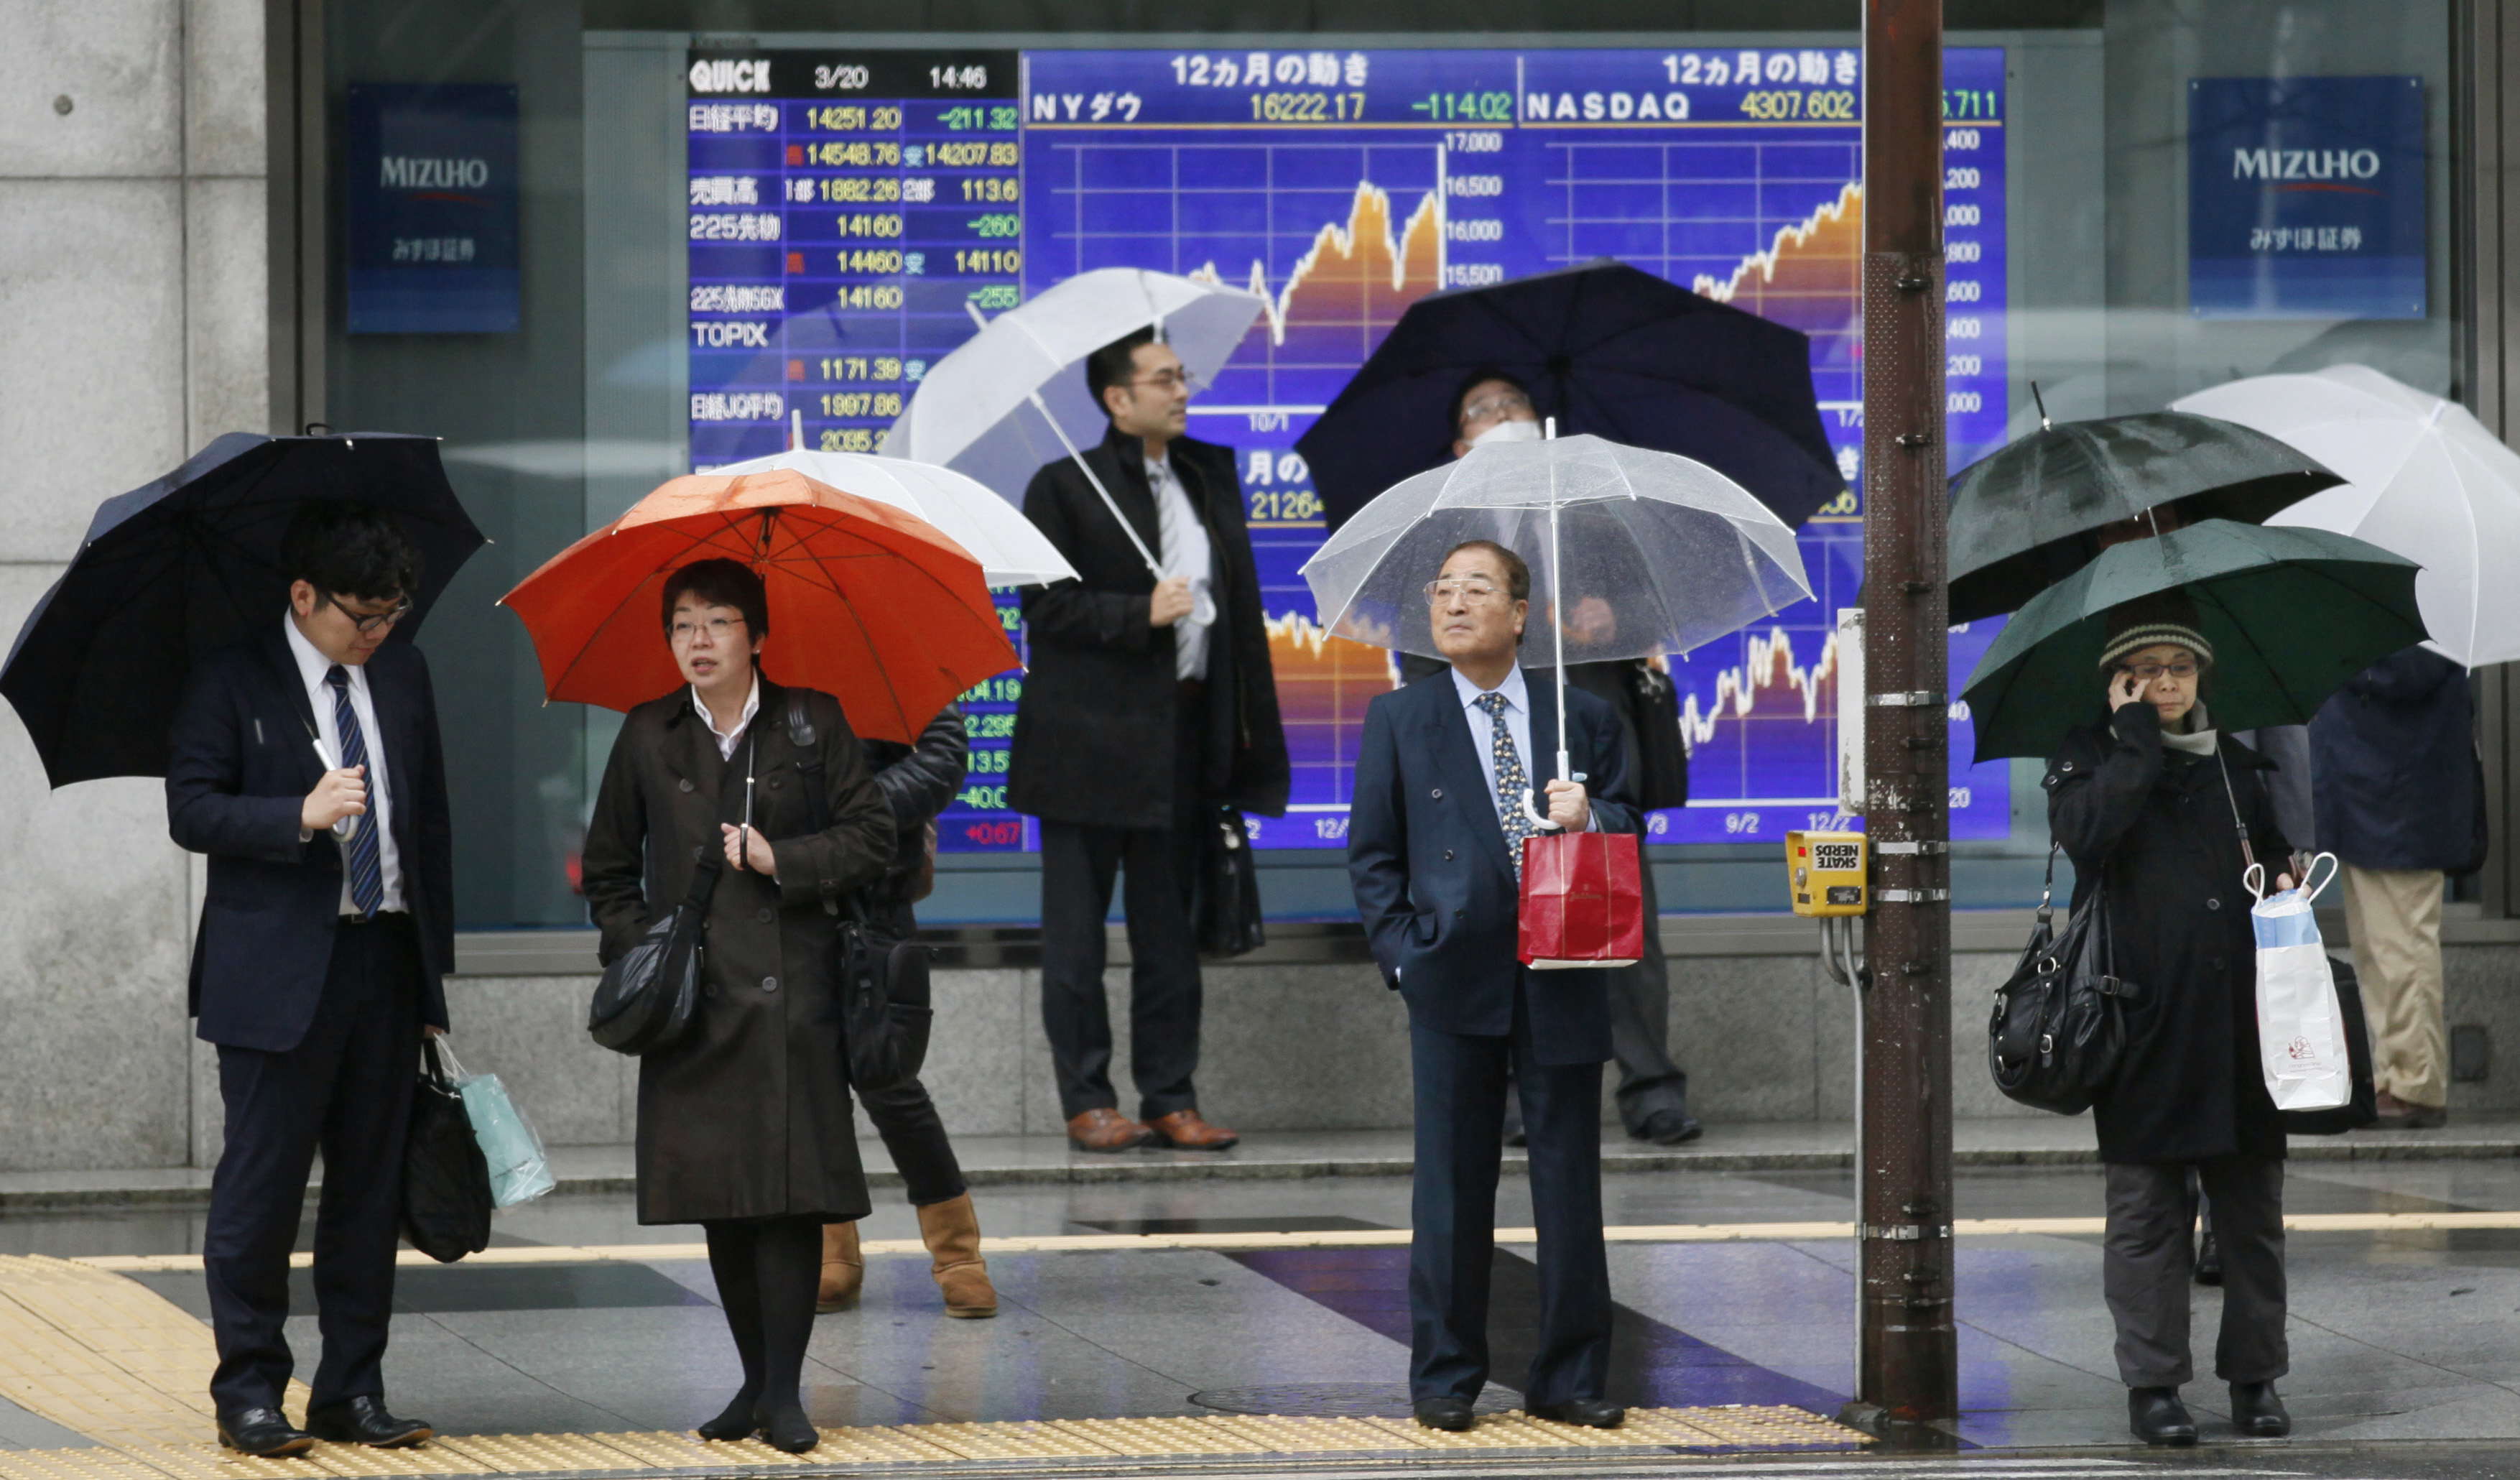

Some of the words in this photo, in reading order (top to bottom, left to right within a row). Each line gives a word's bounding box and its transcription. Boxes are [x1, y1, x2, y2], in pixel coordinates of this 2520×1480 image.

[689, 60, 771, 92] QUICK
[815, 65, 869, 89] 3/20
[930, 65, 988, 89] 14:46
[690, 103, 778, 132] 日経平均
[807, 106, 902, 130] 14251.20
[937, 106, 1019, 130] -211.32
[1250, 93, 1365, 121] 16222.17
[1411, 92, 1512, 121] -114.02
[1527, 93, 1690, 121] NASDAQ
[1741, 91, 1855, 119] 4307.602
[1445, 133, 1503, 153] 17,000
[380, 156, 489, 188] MIZUHO
[2233, 147, 2381, 179] MIZUHO
[1446, 176, 1503, 197] 16,500
[690, 213, 781, 241] 225先物
[837, 214, 902, 238] 14160
[968, 214, 1020, 238] -260
[1446, 220, 1503, 242] 16,000
[2250, 226, 2362, 251] みずほ証券
[393, 238, 475, 262] みずほ証券
[837, 251, 902, 273] 14460
[955, 251, 1020, 273] 14110
[838, 286, 903, 310] 14160
[967, 286, 1019, 309] -255
[690, 321, 769, 347] TOPIX
[1726, 812, 1760, 834] 9/2
[1815, 844, 1859, 856] NERDS
[1817, 856, 1857, 869] SKATE
